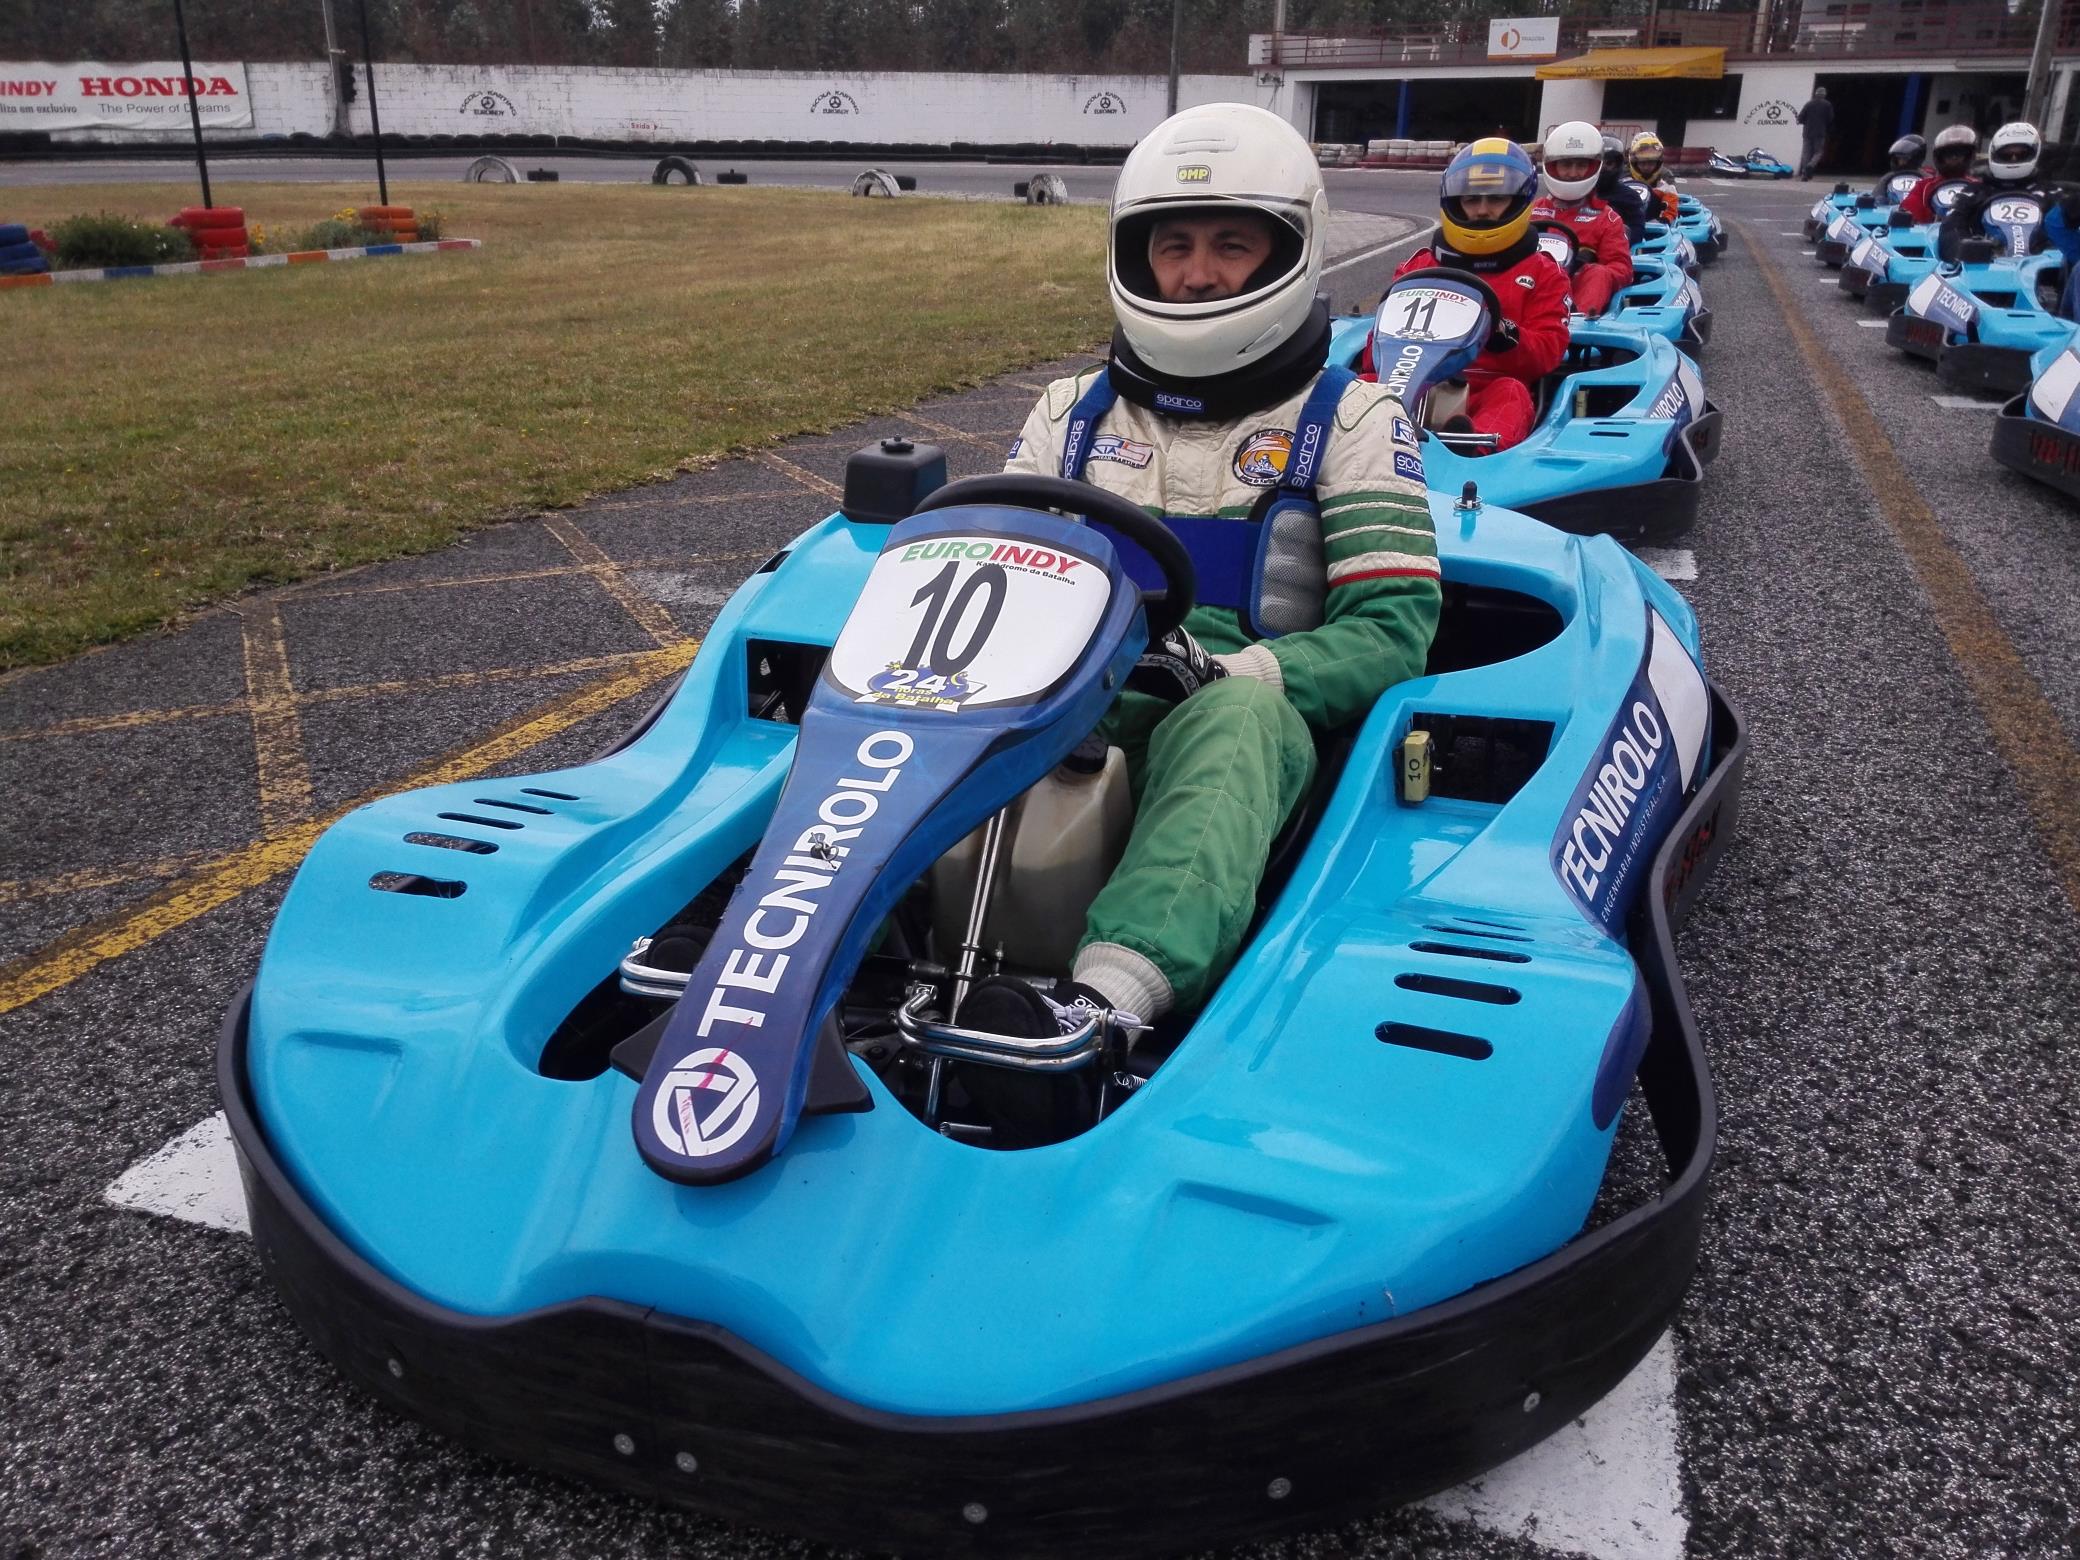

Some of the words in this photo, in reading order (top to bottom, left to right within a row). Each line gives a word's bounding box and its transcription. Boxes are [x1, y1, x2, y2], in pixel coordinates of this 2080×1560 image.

[79, 77, 238, 97] HONDA
[36, 103, 77, 113] exclusivo
[99, 103, 122, 113] The
[127, 103, 163, 113] Power
[168, 103, 180, 113] of
[184, 103, 231, 113] Deams
[1178, 168, 1208, 181] OMP
[2001, 205, 2030, 220] 26
[1398, 290, 1469, 303] EUROINDY
[1937, 286, 1973, 322] TECNIRO
[1403, 297, 1437, 332] 11
[1388, 345, 1423, 398] CNIROLO
[1156, 394, 1202, 408] sparco
[1652, 382, 1685, 418] NIROLO
[1065, 420, 1084, 480] sparco
[1291, 424, 1319, 487] sparco
[901, 541, 1081, 575] EUROINDY
[1029, 567, 1041, 575] da
[1042, 571, 1076, 586] Batalha
[902, 560, 1008, 677] 10
[881, 669, 948, 694] 24
[894, 687, 933, 695] horas
[895, 693, 955, 705] Batalha
[1408, 758, 1421, 782] 10
[1561, 701, 1663, 902] TECNIROLO
[697, 730, 915, 1037] TECNIROLO
[1601, 853, 1633, 923] ENGENHARIA
